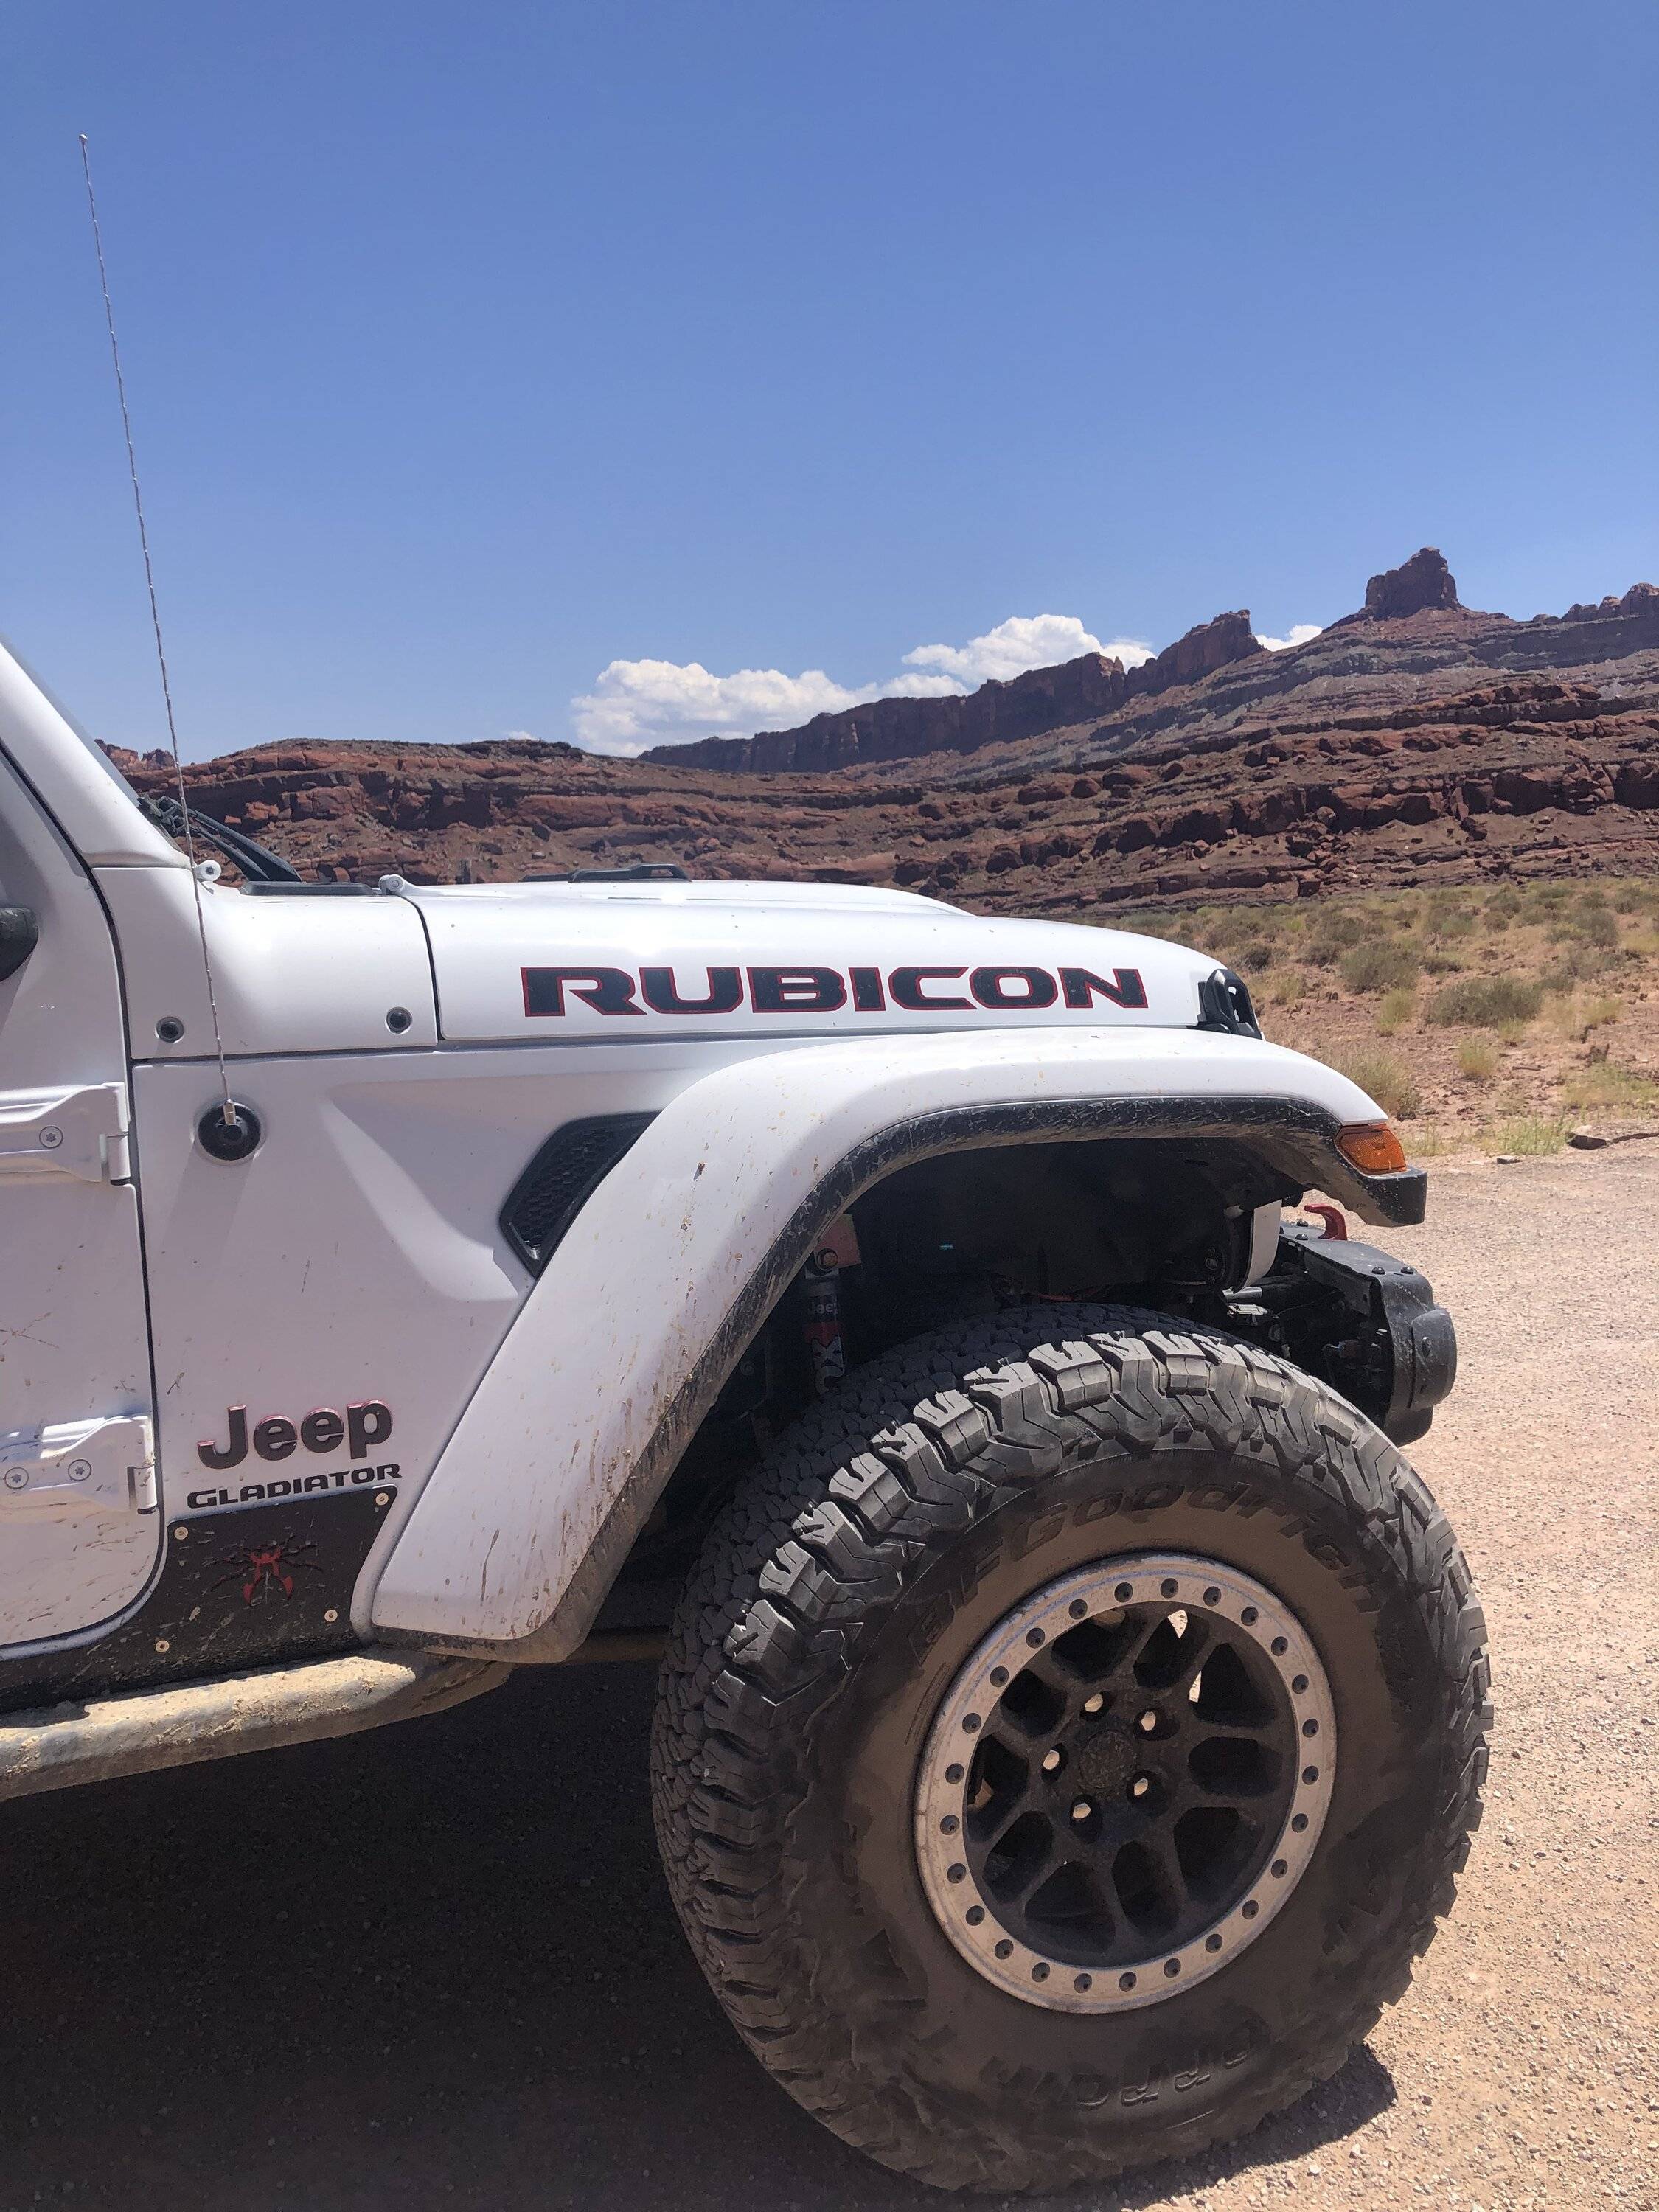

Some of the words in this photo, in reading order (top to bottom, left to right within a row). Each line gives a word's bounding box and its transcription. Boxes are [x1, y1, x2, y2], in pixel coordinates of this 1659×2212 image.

[521, 965, 1150, 1018] RUBICON
[197, 1399, 393, 1470] Jeep
[187, 1463, 403, 1509] GLADIATOR
